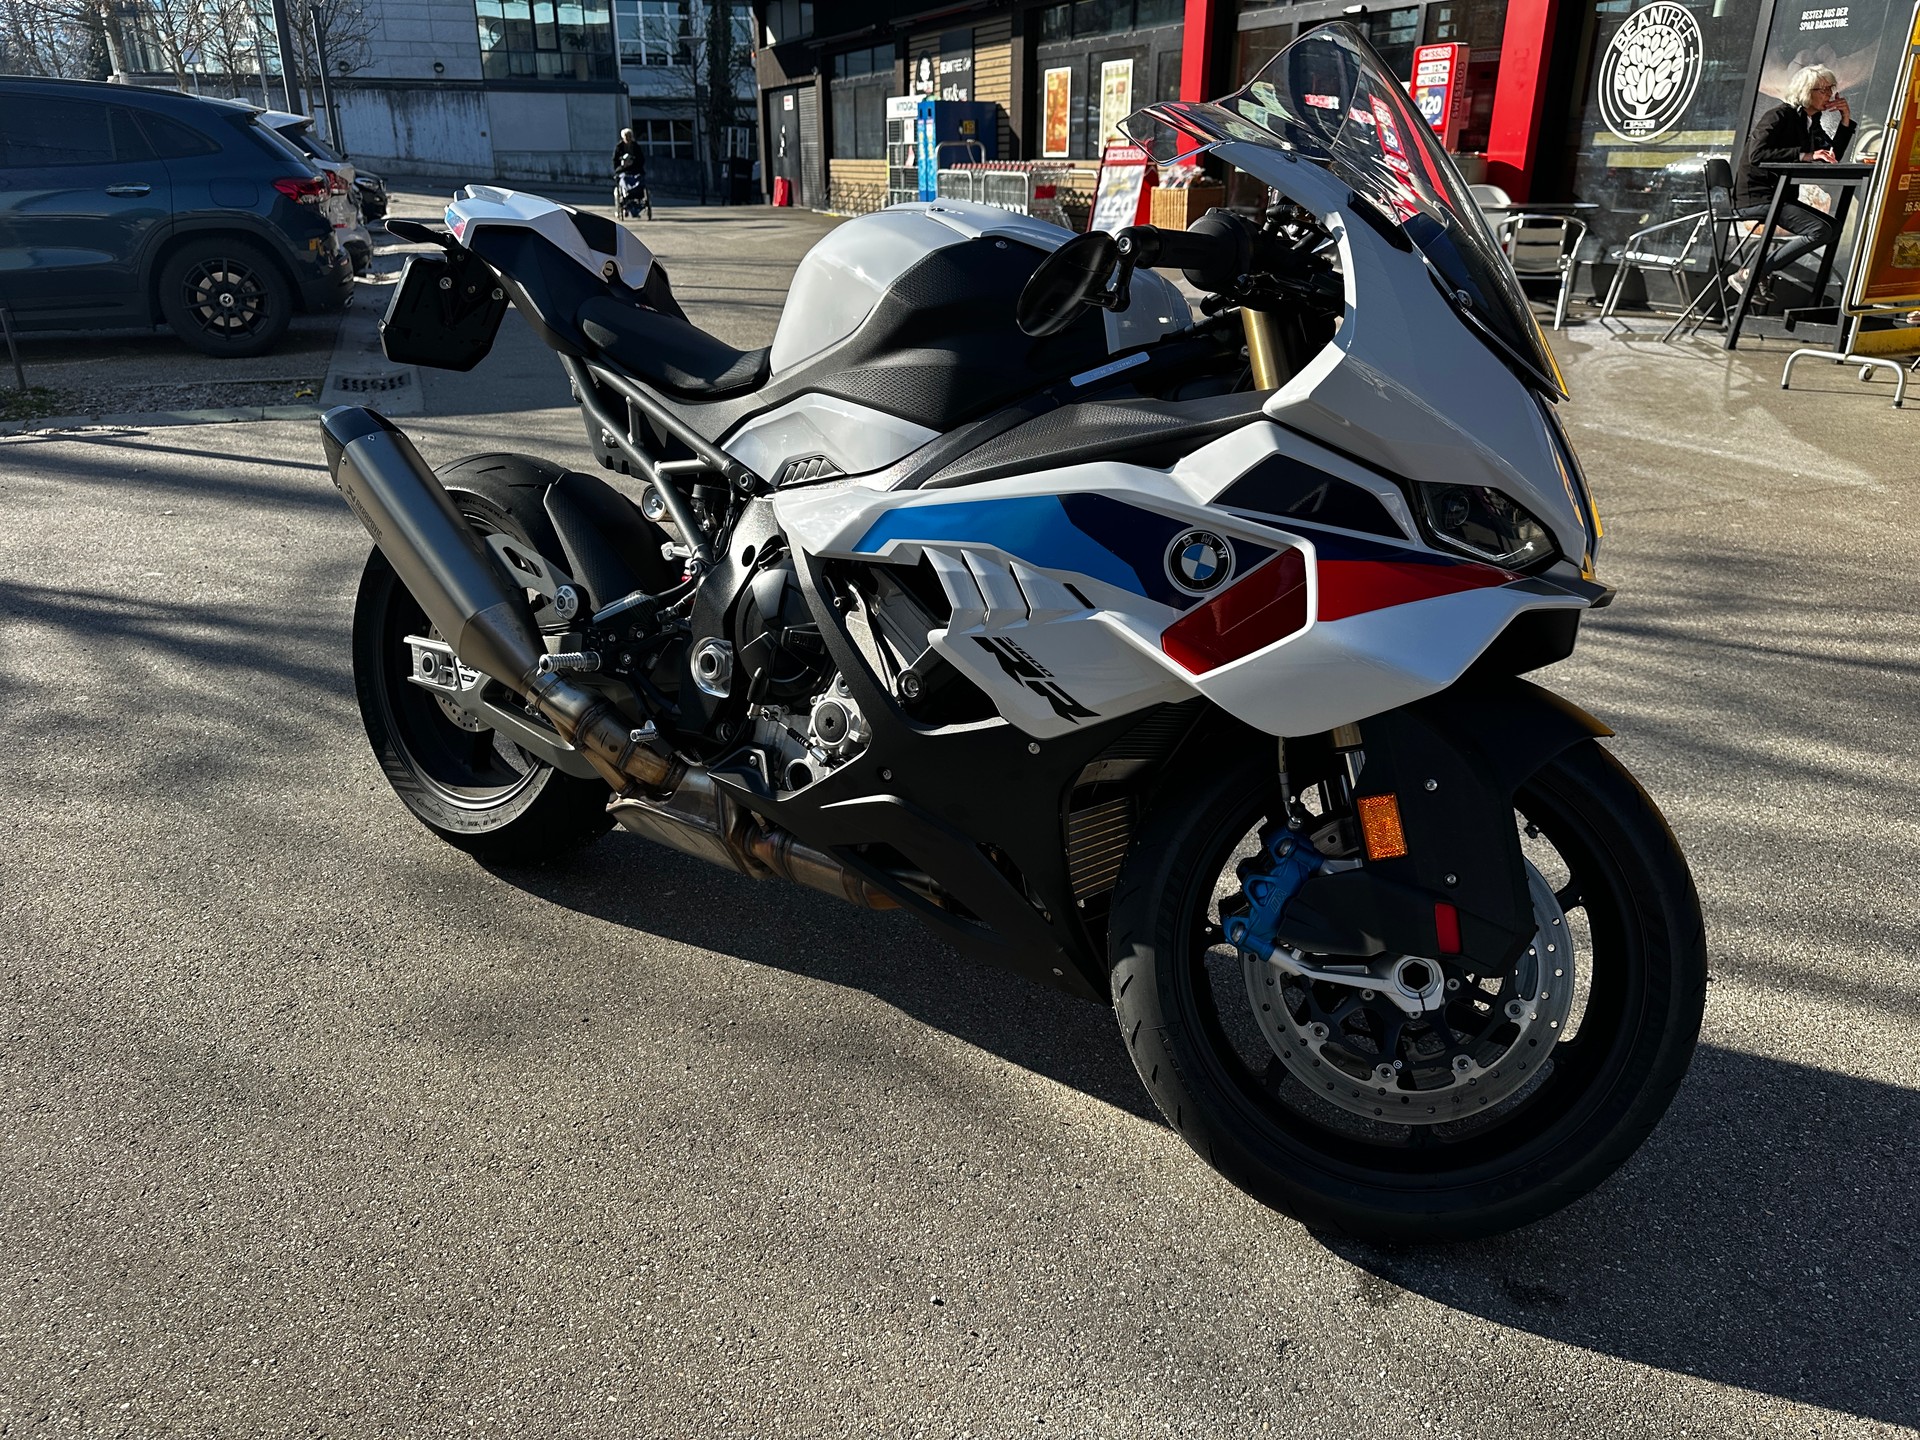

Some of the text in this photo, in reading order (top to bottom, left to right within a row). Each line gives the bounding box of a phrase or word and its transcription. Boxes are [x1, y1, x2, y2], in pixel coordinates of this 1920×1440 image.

[1802, 7, 1849, 20] BESTES AUS DER
[1614, 5, 1698, 53] BEANTREE
[1799, 21, 1815, 31] SPAR
[1420, 48, 1452, 60] SWISSLOS
[1182, 533, 1229, 559] BMW
[970, 636, 1101, 726] RR
